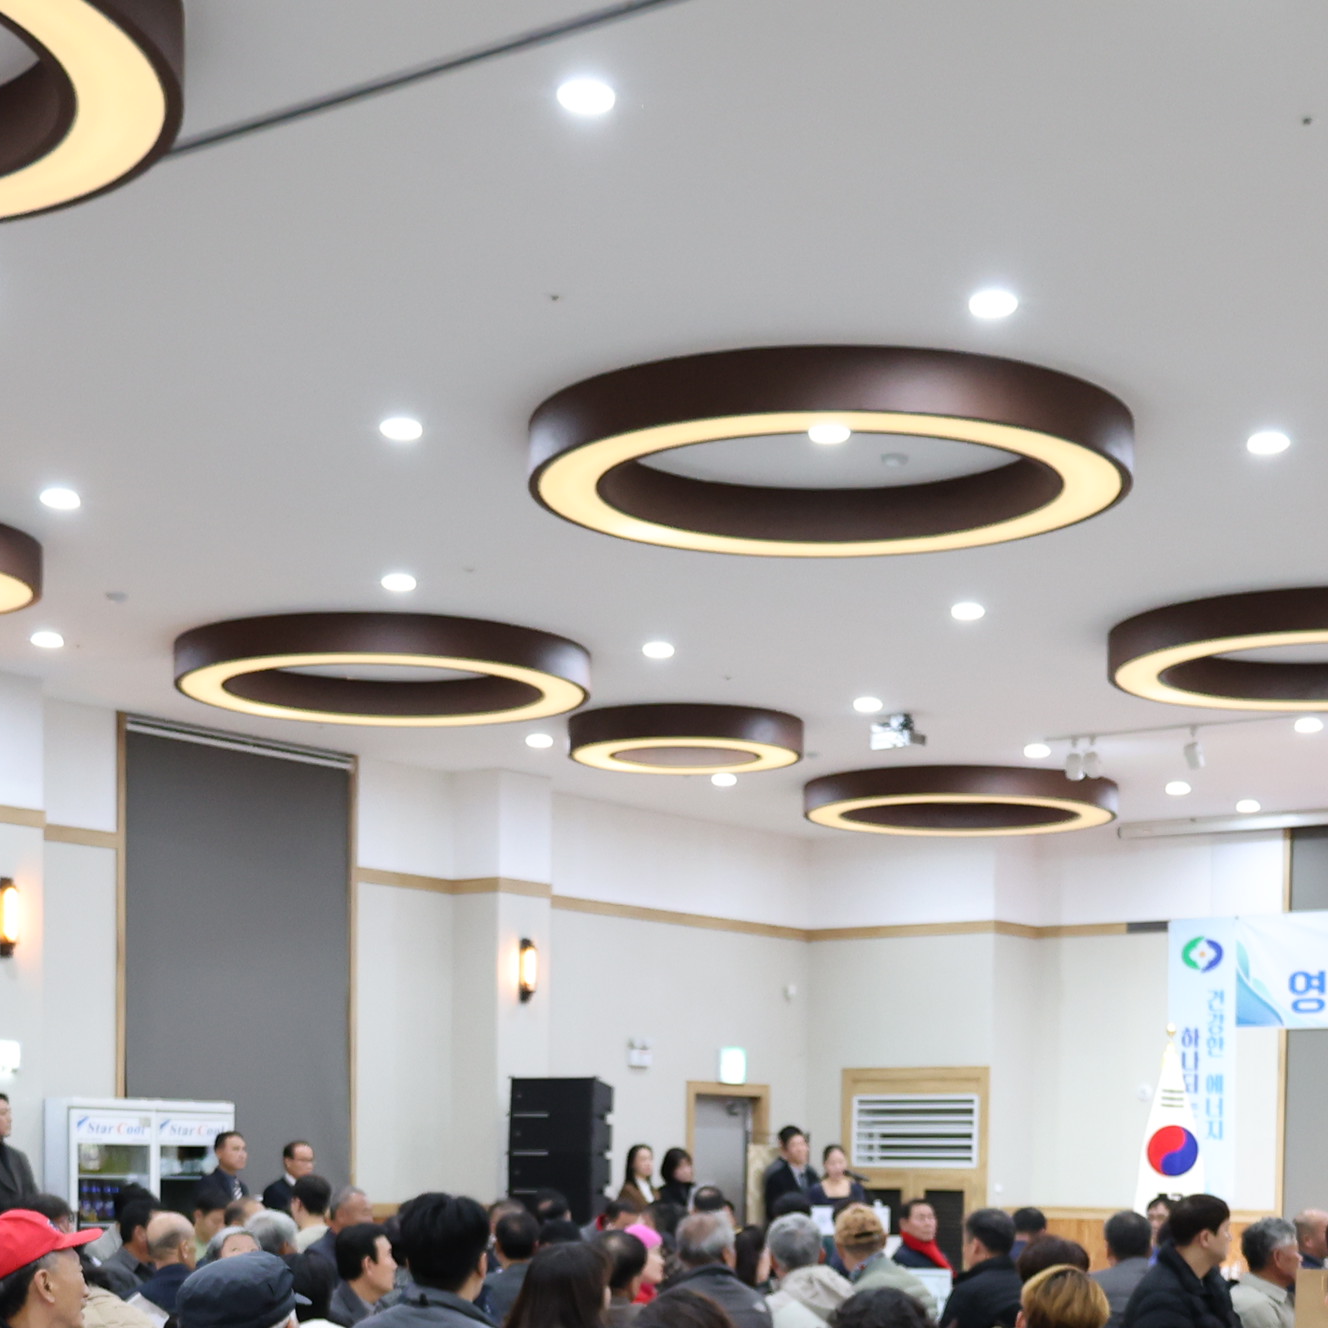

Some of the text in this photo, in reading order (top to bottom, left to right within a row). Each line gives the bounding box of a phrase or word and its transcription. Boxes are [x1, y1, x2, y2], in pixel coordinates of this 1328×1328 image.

[86, 1119, 146, 1136] Star Cool
[169, 1120, 195, 1136] Star
